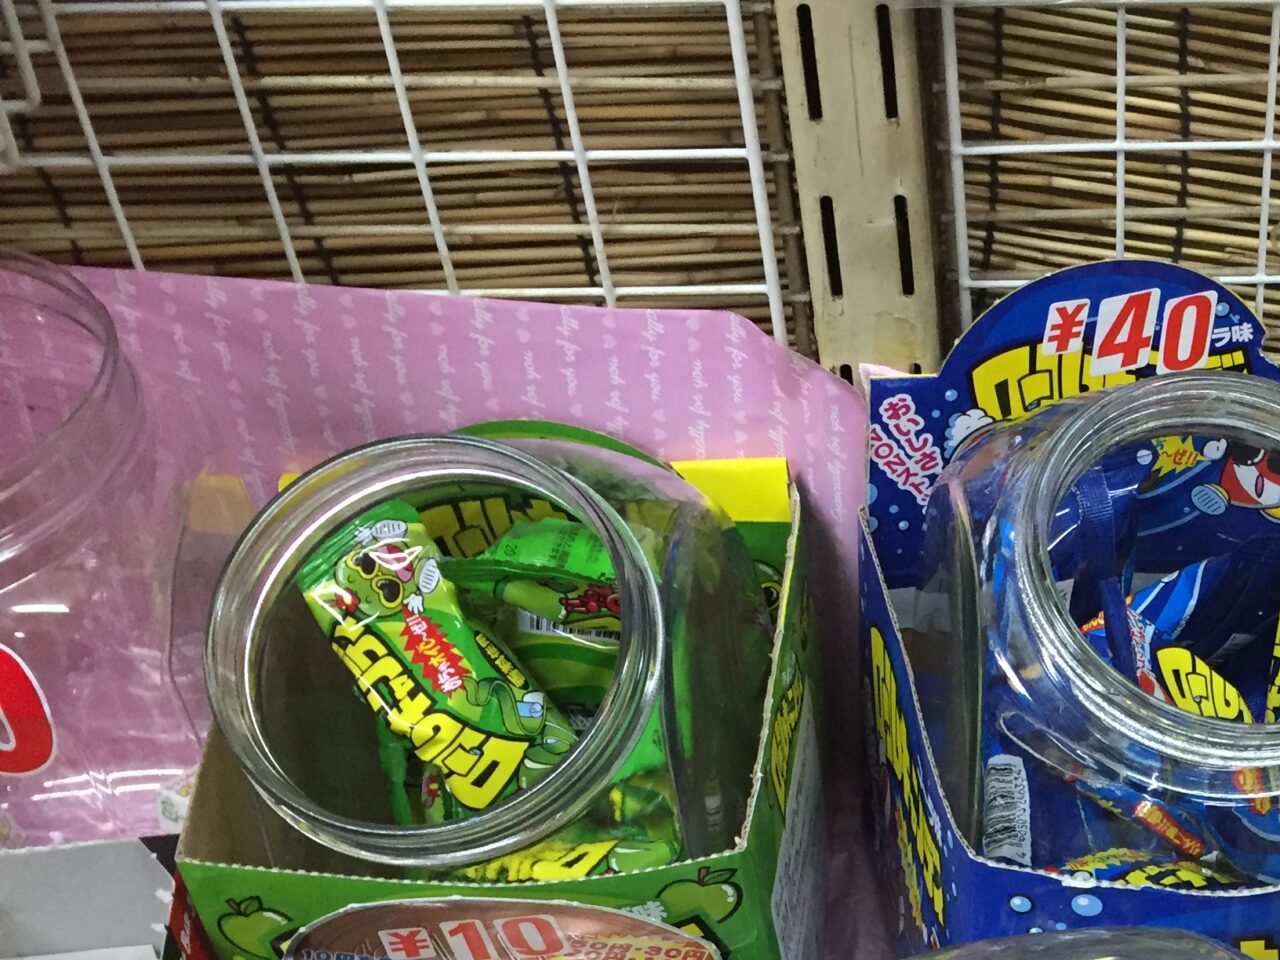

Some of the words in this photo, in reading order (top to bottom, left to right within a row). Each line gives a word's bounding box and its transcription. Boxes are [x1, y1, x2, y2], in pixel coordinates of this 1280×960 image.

[1049, 292, 1213, 371] ¥40
[881, 394, 942, 471] おいしさ
[332, 614, 530, 810] ロールキャンディ
[387, 917, 561, 960] ¥10
